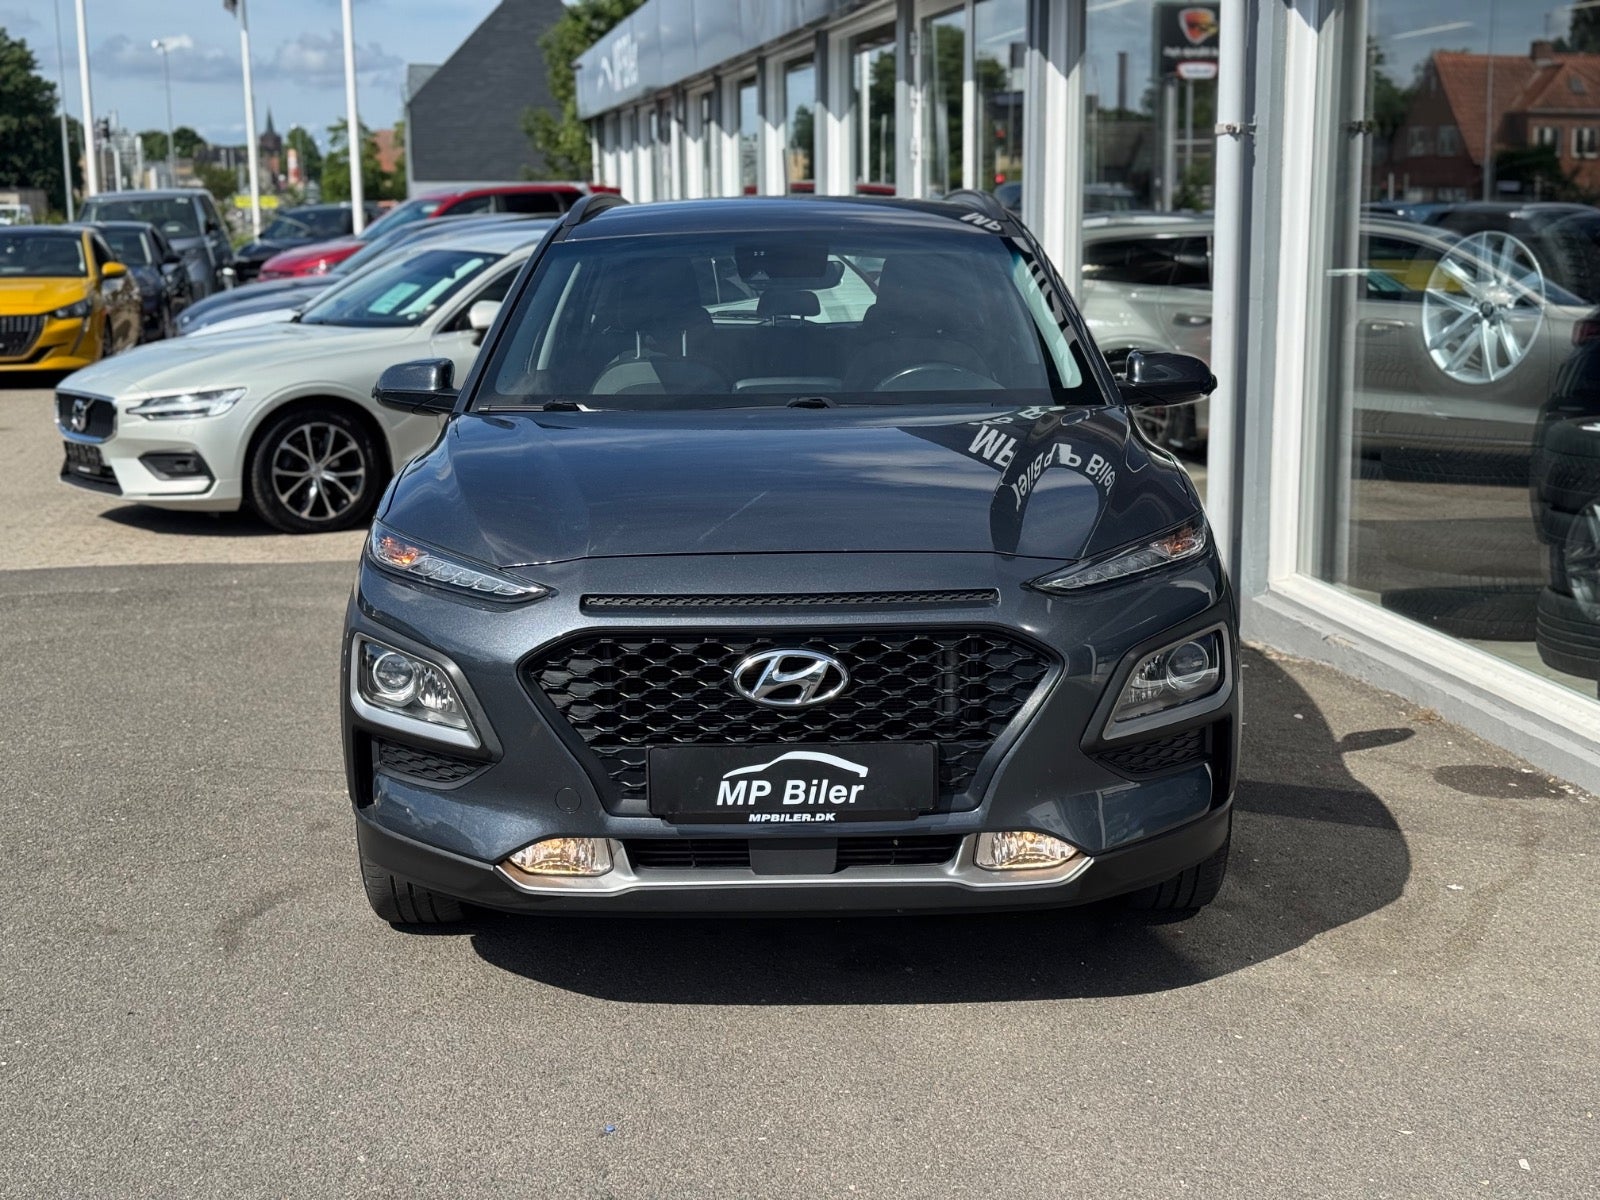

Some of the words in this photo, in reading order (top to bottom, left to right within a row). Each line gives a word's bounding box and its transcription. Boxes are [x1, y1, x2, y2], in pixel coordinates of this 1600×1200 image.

[716, 780, 772, 806] MP
[782, 778, 865, 805] Biler
[748, 812, 837, 822] MPBILER.DK
